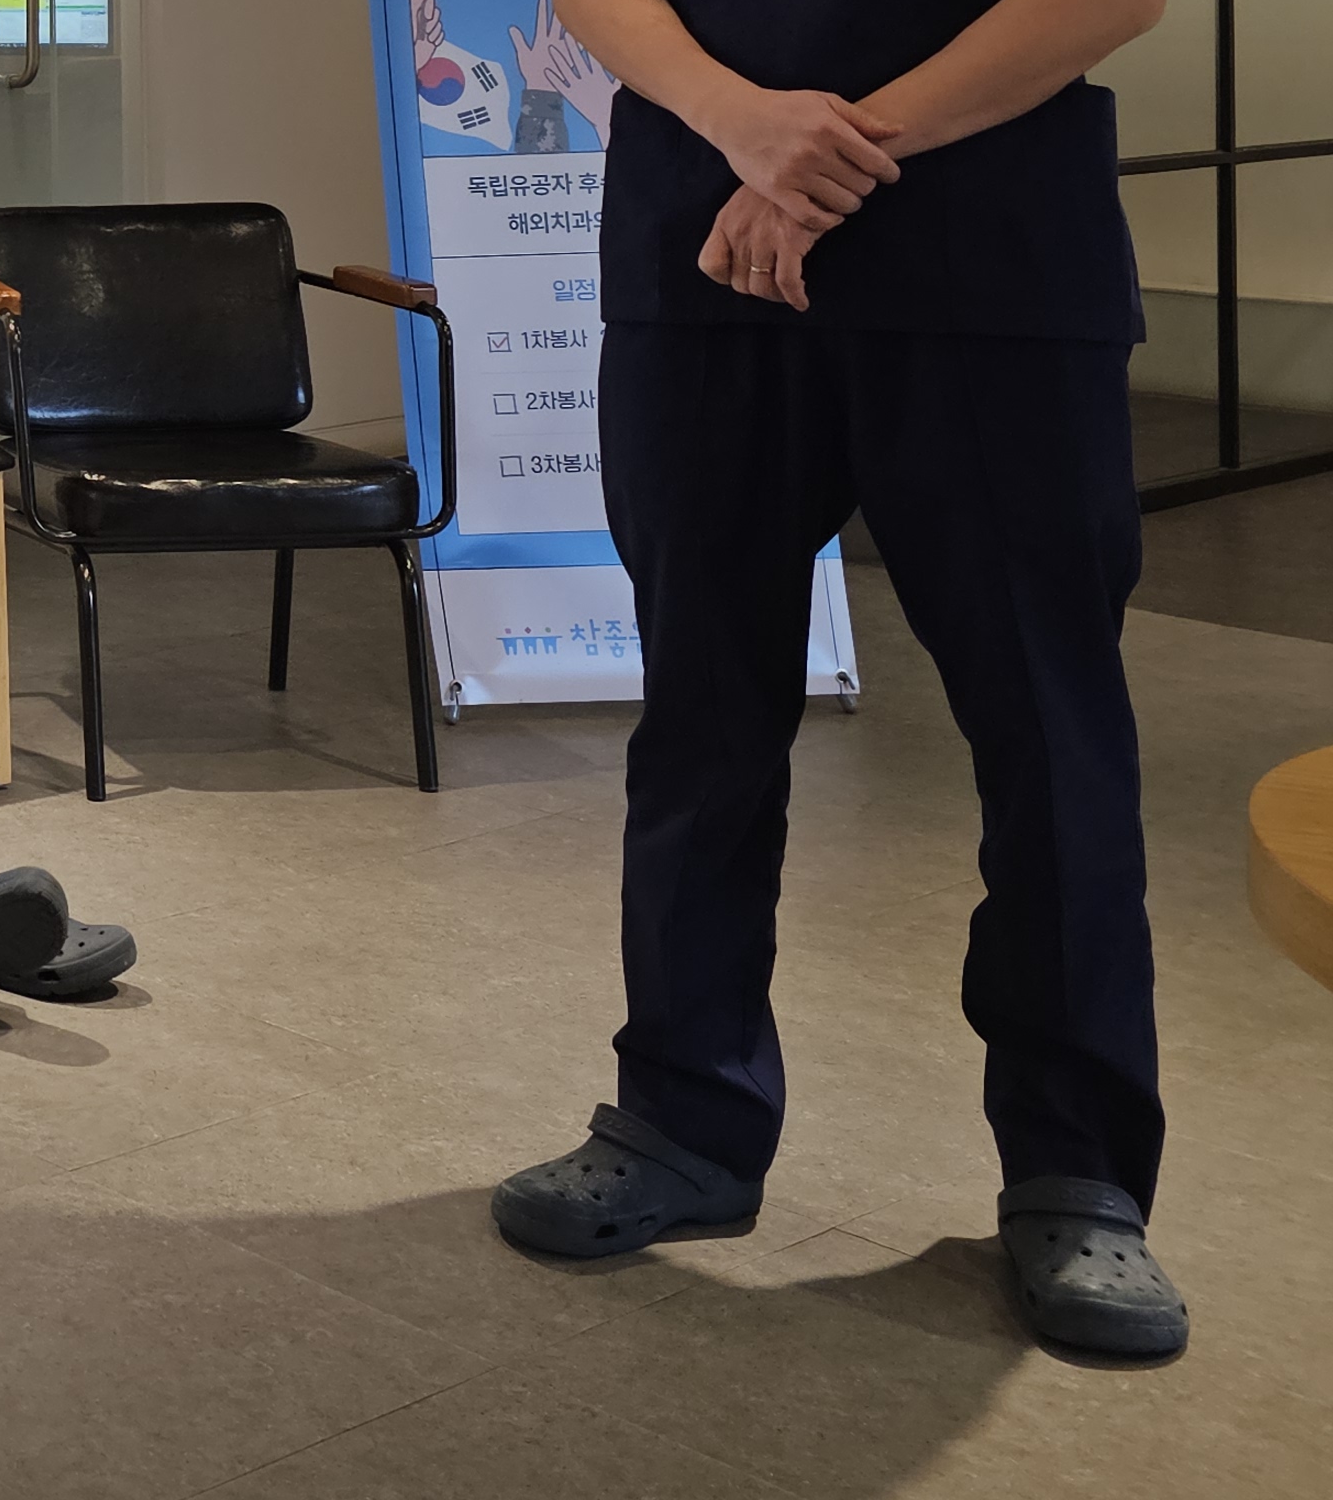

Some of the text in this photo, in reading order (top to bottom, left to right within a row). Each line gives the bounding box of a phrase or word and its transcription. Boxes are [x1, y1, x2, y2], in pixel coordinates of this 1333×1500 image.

[467, 173, 573, 198] 독립유공자
[553, 278, 597, 302] 일정
[521, 329, 588, 349] 1차봉사
[525, 389, 596, 410] 2차봉사
[531, 452, 601, 474] 3차봉사
